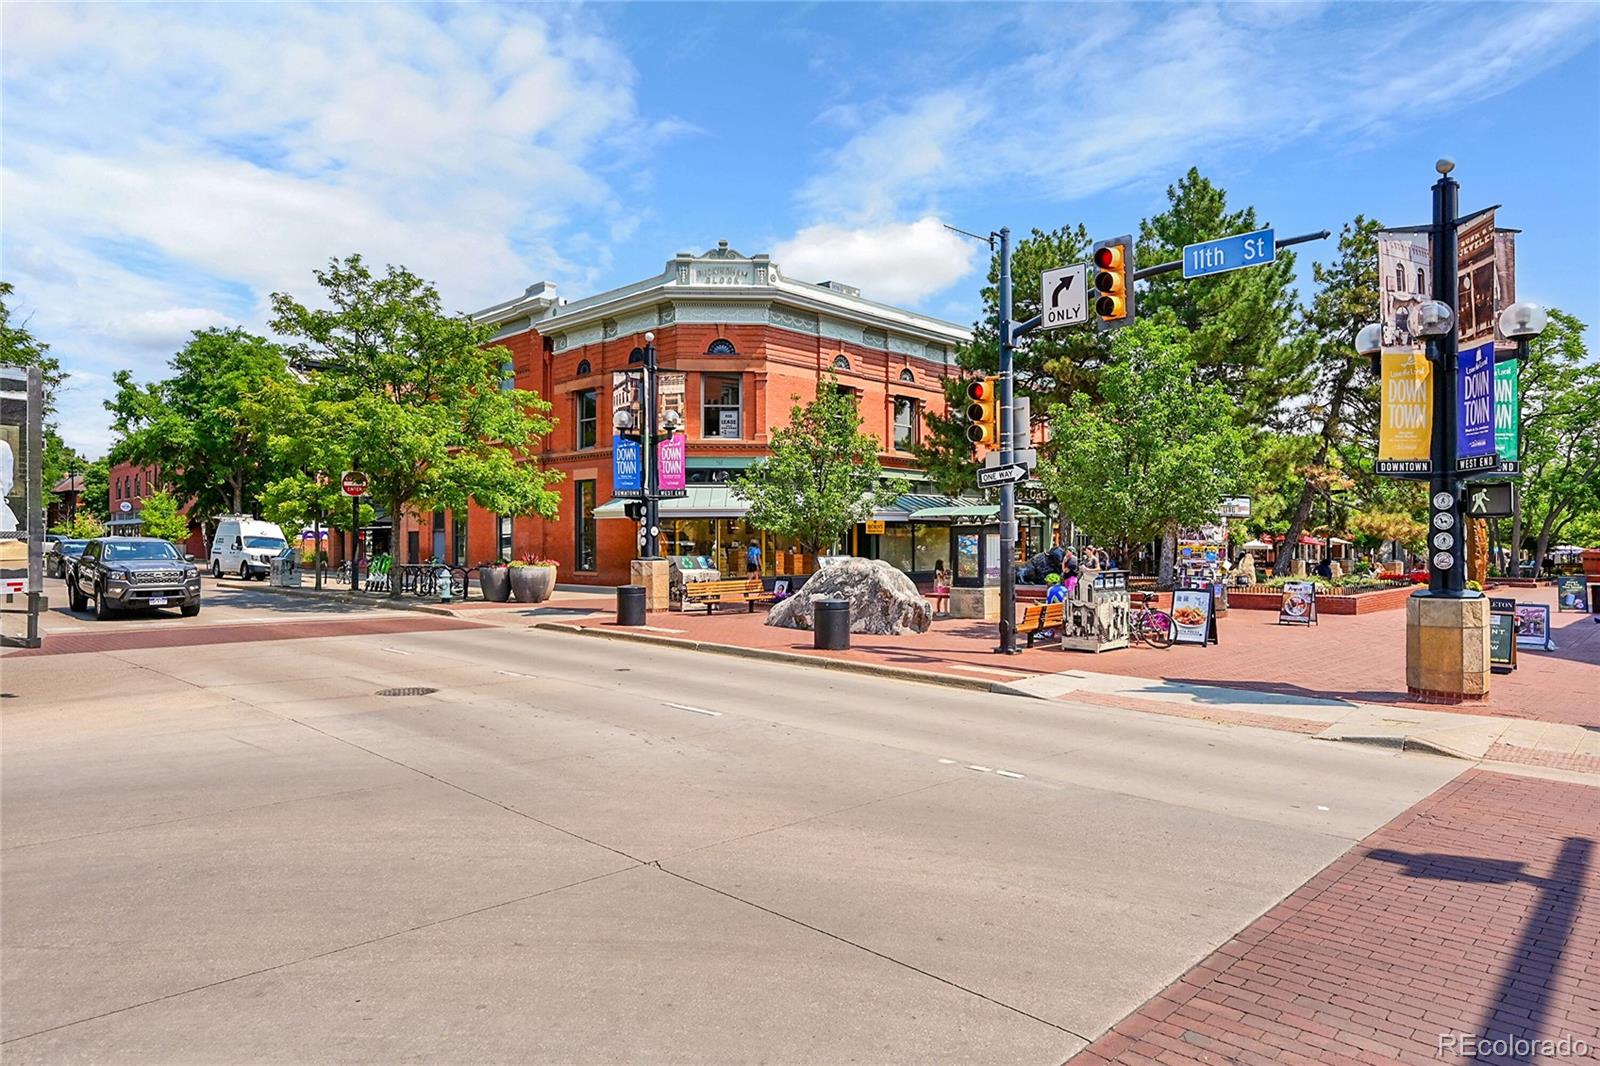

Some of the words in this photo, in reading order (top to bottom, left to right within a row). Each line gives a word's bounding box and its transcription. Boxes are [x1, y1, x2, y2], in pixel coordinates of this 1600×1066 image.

[1193, 247, 1224, 270] 11th
[1244, 237, 1265, 260] St
[705, 277, 740, 285] BLOCK
[1048, 304, 1081, 323] ONLY
[1389, 378, 1427, 402] DOWN
[1464, 370, 1490, 400] DOWN
[1495, 379, 1512, 402] WN
[1388, 404, 1427, 429] TOWN
[1464, 397, 1490, 426] TOWN
[1495, 405, 1512, 429] WN
[616, 448, 636, 460] DOWN
[661, 448, 682, 460] DOWN
[616, 461, 637, 474] TOWN
[661, 461, 682, 474] TOWN
[1381, 462, 1428, 471] DOWNTOWN
[1459, 458, 1477, 469] WEST
[1479, 456, 1493, 467] END
[983, 472, 997, 481] ONE
[999, 470, 1013, 479] WAY
